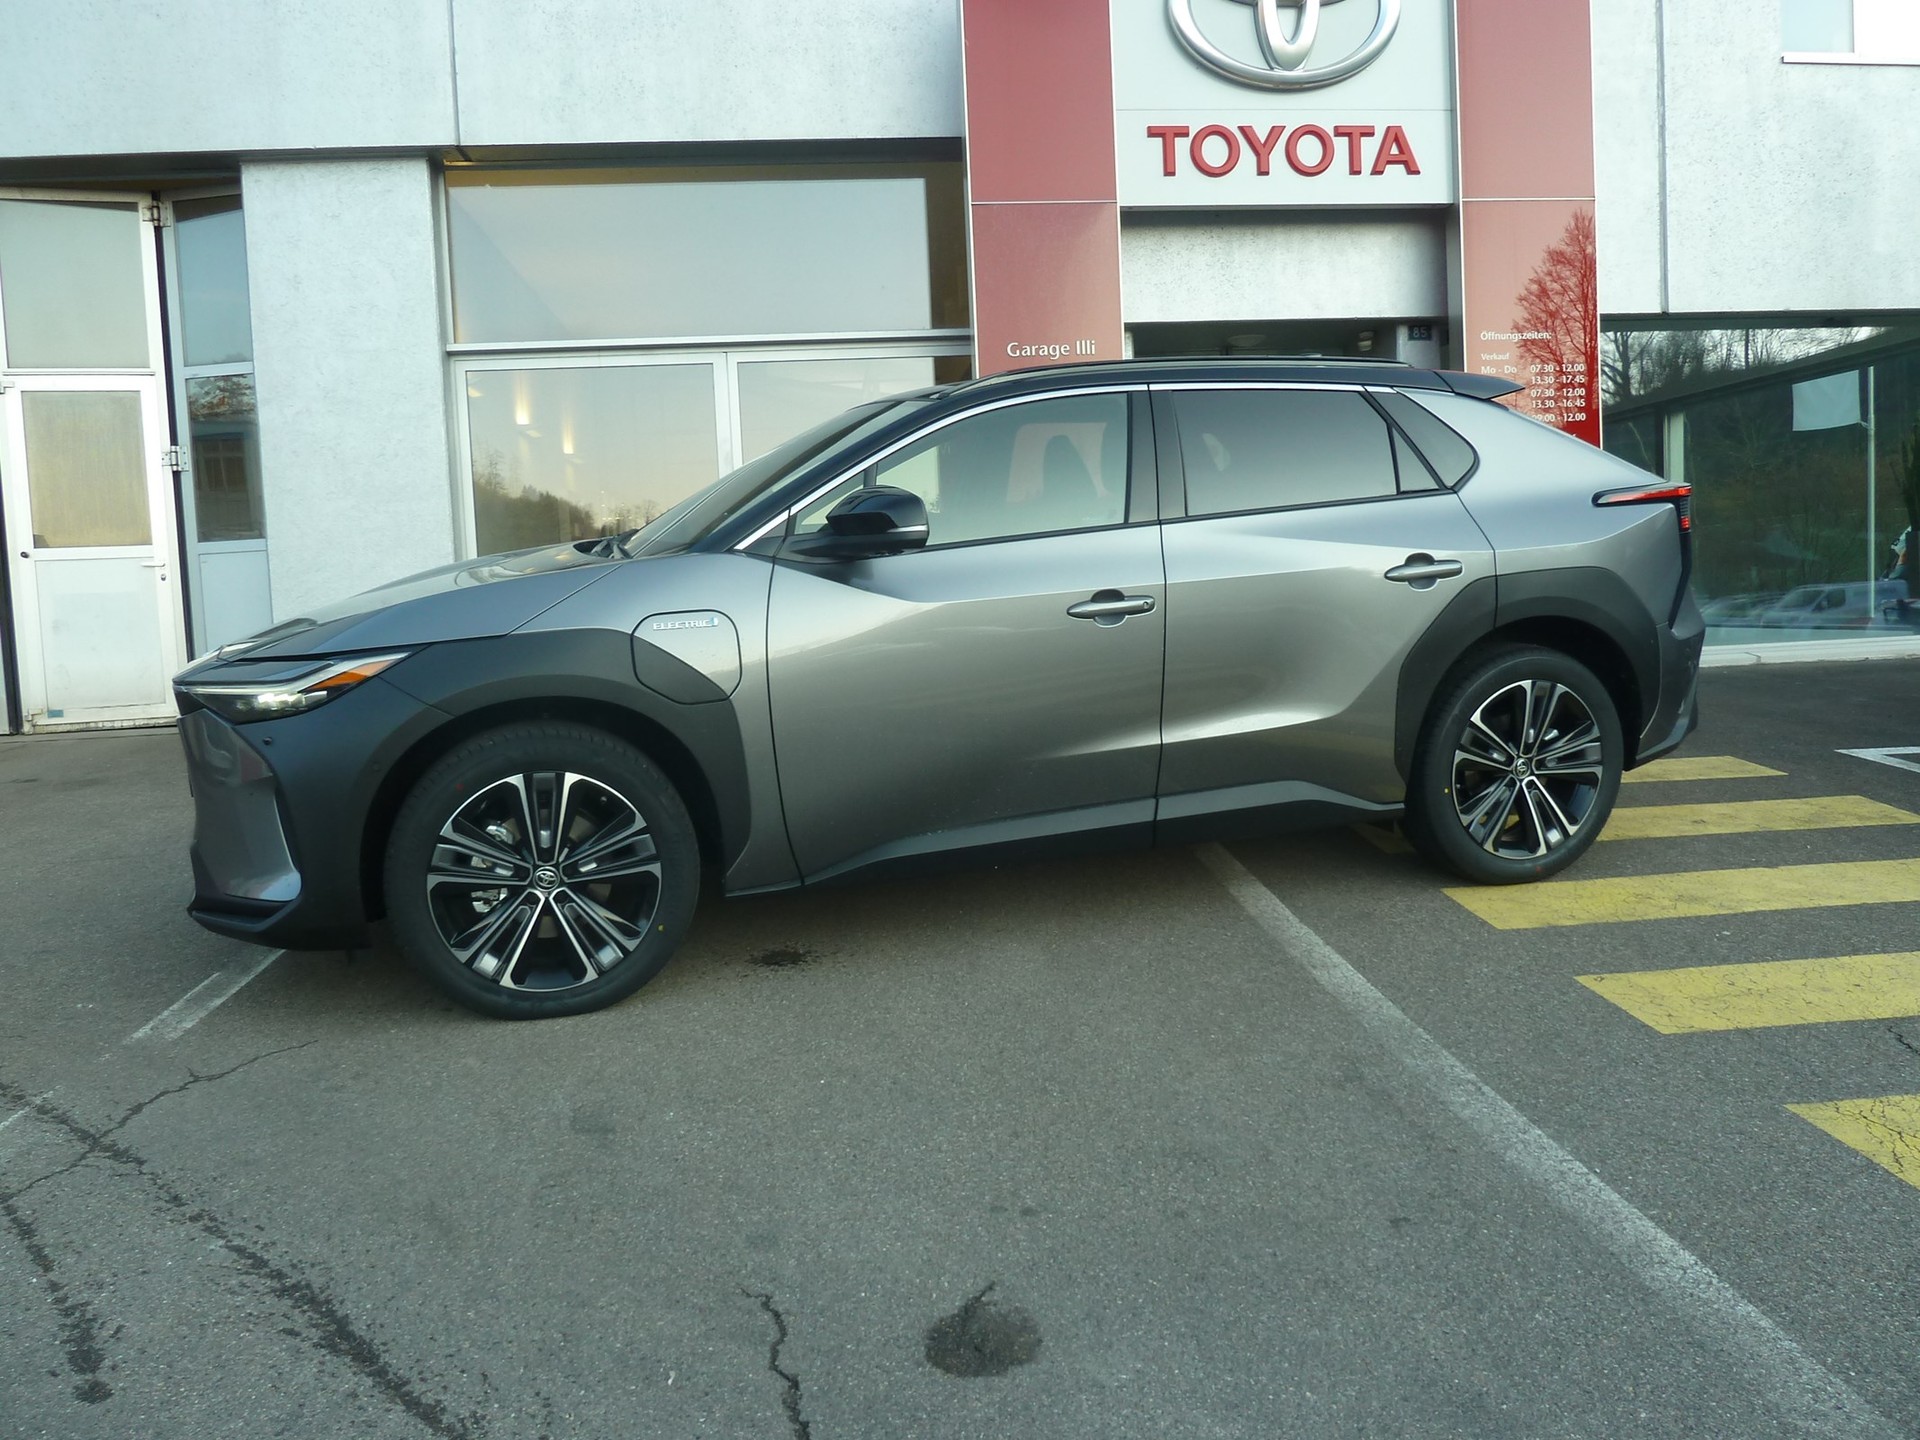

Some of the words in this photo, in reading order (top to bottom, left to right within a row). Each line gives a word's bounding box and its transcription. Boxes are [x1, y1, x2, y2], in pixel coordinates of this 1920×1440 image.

[1147, 124, 1421, 177] TOYOTA
[1413, 326, 1428, 338] 85
[1480, 331, 1552, 342] Öffnungszeiten:
[1007, 342, 1070, 360] Garage
[1076, 340, 1096, 355] Illi
[1481, 352, 1510, 361] Verkauf
[1481, 366, 1496, 374] Mo
[1504, 365, 1518, 374] Do
[1530, 364, 1555, 373] 07.30
[1562, 363, 1585, 372] 12.00
[1531, 375, 1555, 385] 13.30
[1562, 375, 1585, 384] 17.45
[1530, 388, 1555, 398] 07.30
[1563, 387, 1586, 397] 12.00
[1532, 399, 1555, 409] 13.30
[1563, 399, 1586, 408] 16.45
[1563, 412, 1587, 422] 12.00
[652, 619, 712, 630] ELECTRIC
